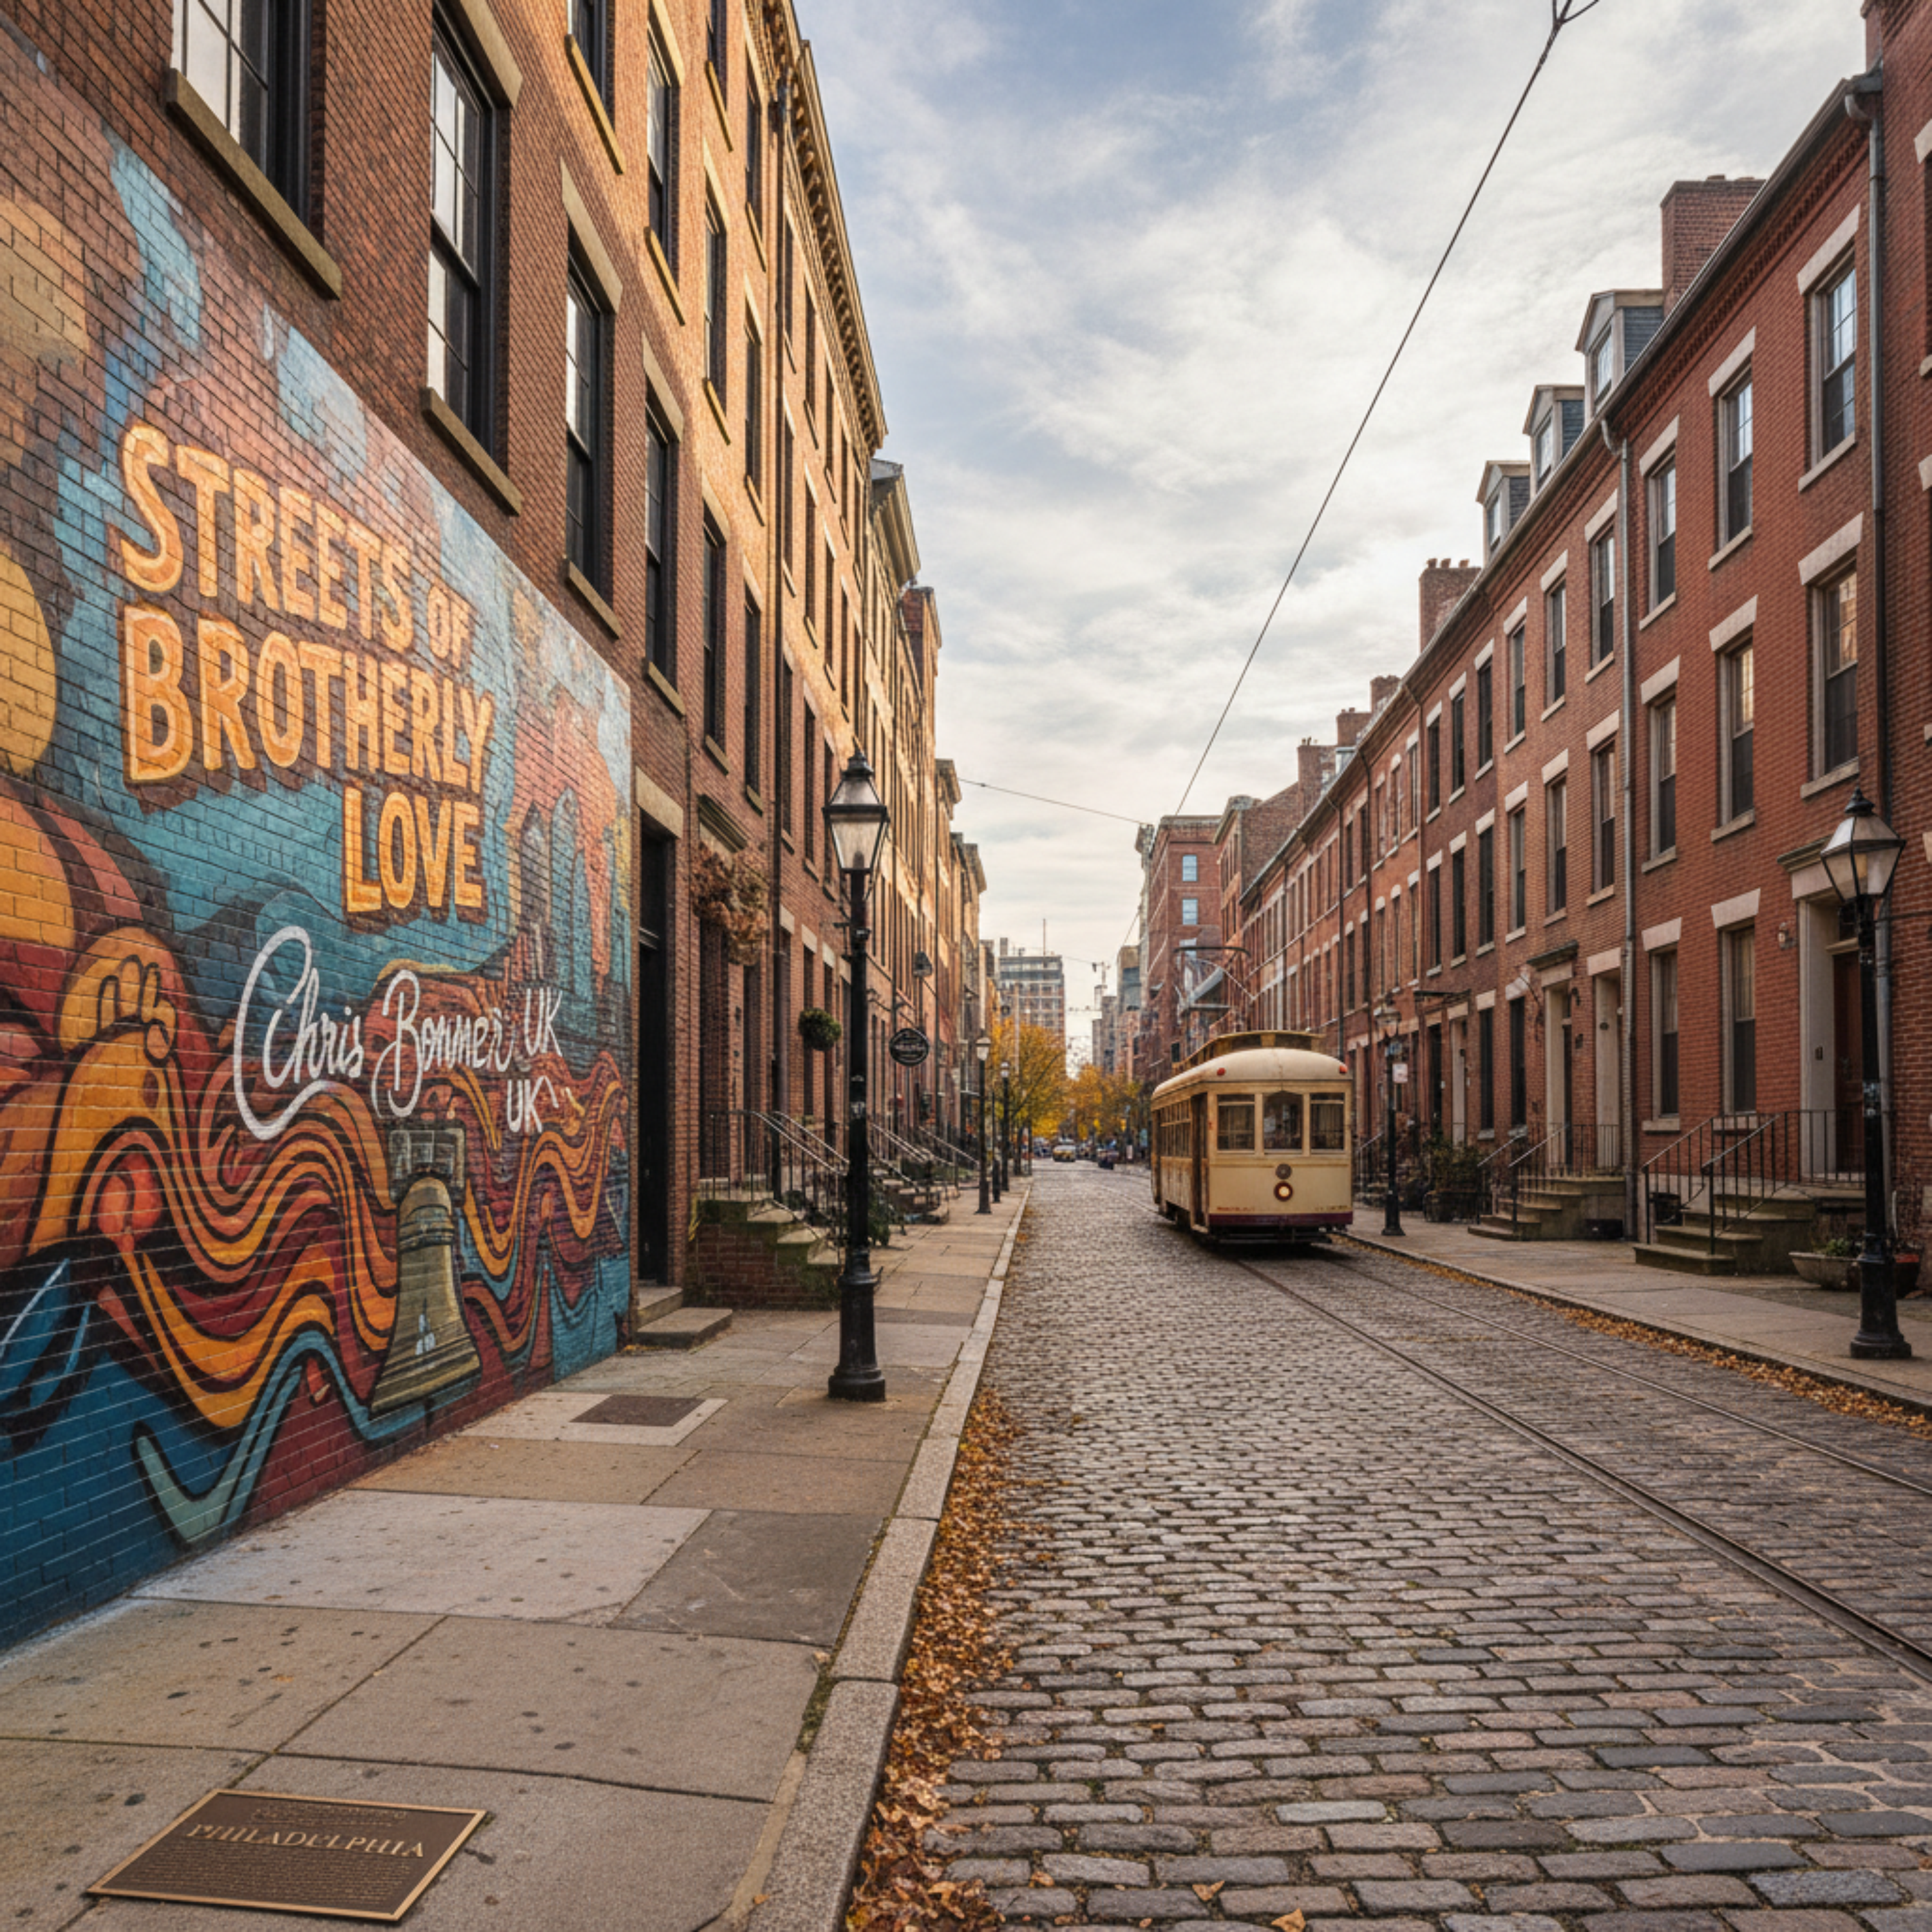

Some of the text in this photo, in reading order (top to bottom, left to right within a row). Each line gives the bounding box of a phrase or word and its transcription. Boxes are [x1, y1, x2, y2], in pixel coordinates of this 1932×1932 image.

[120, 424, 473, 669] STREETS OF
[124, 605, 495, 794] BROTHERLY
[343, 786, 483, 913] LOVE
[233, 925, 364, 1140] Chris
[524, 986, 563, 1057] UK
